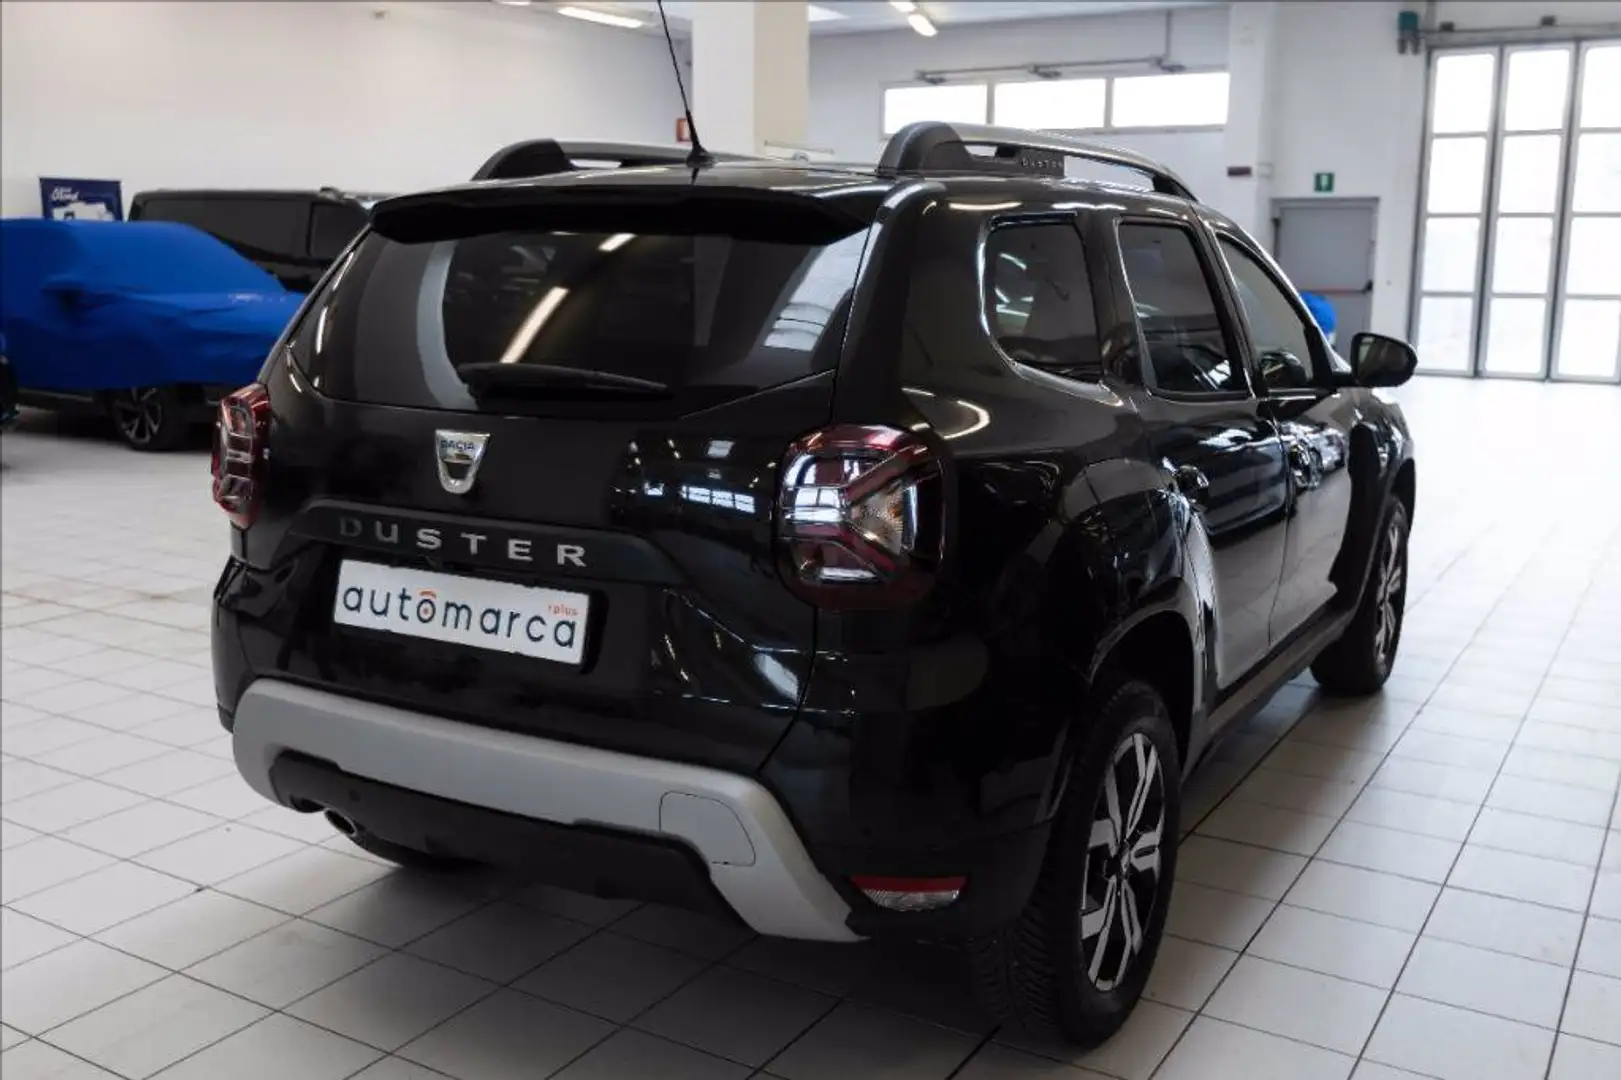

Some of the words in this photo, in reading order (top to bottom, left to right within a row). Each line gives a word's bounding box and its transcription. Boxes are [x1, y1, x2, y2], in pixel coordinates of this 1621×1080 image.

[440, 440, 475, 450] DACIA
[340, 517, 586, 567] DUSTER
[343, 587, 576, 648] automarca
